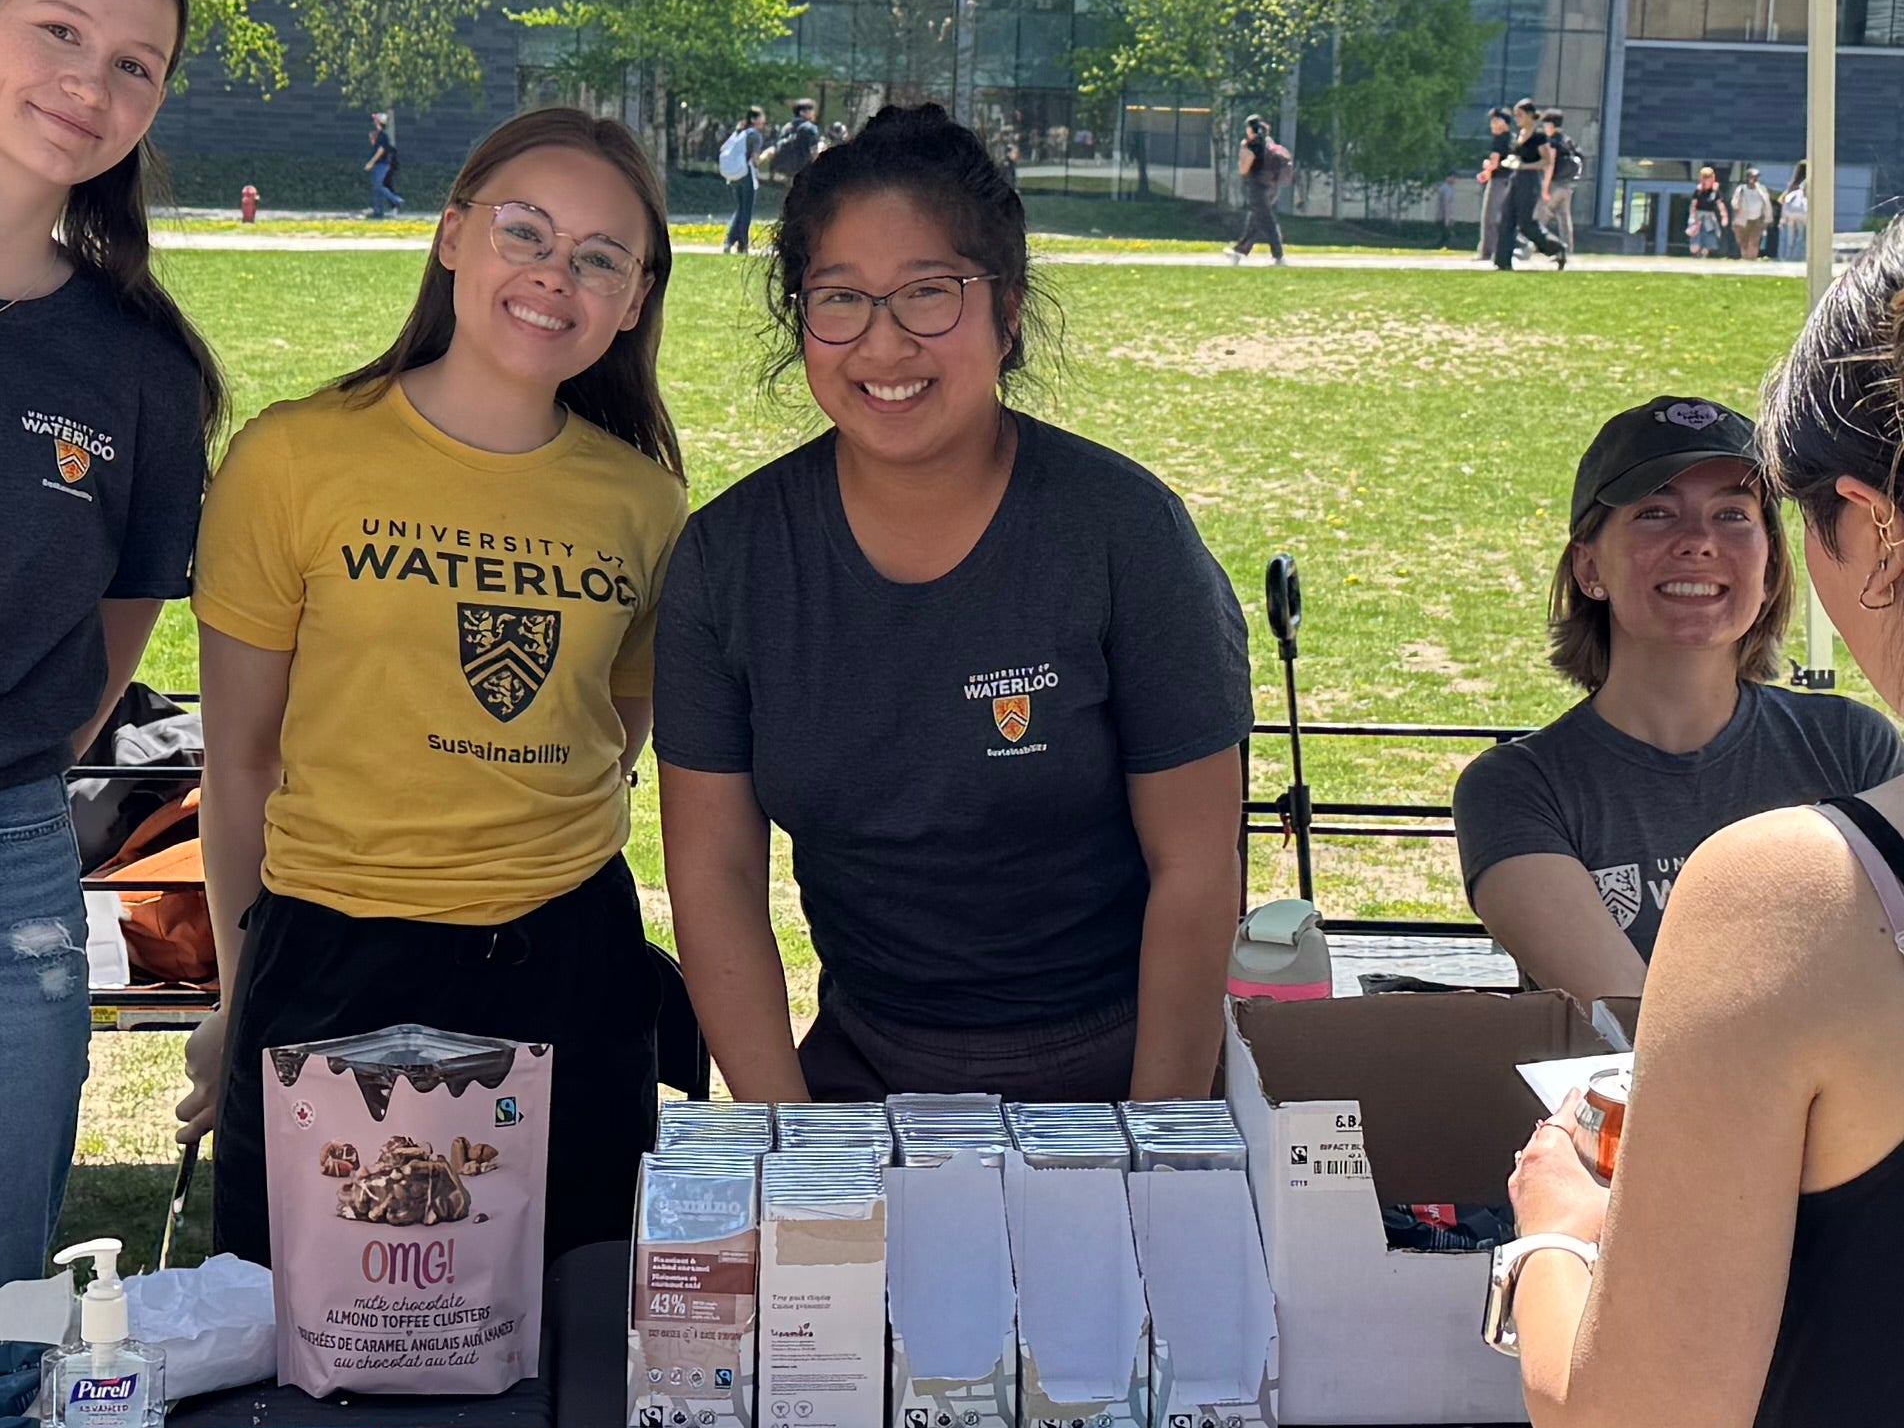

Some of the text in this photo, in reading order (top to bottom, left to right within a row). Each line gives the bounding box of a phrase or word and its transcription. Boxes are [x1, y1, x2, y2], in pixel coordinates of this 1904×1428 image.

[21, 415, 115, 461] WATERLOO
[362, 518, 576, 559] UNIVERSITY
[963, 672, 1059, 700] WATERLOO
[428, 733, 571, 766] Sustainability
[1335, 1114, 1362, 1128] &B
[361, 1237, 456, 1290] OMG!
[353, 1292, 466, 1312] milk chocolate
[650, 1293, 686, 1315] 43%
[326, 1305, 491, 1329] ALMOND TOFFEE CLUSTERS
[338, 1337, 353, 1351] DE
[354, 1338, 408, 1352] CARAMEL
[411, 1336, 460, 1352] ANGLAIS
[462, 1332, 482, 1349] AUX
[333, 1350, 480, 1370] au chocolat au lait
